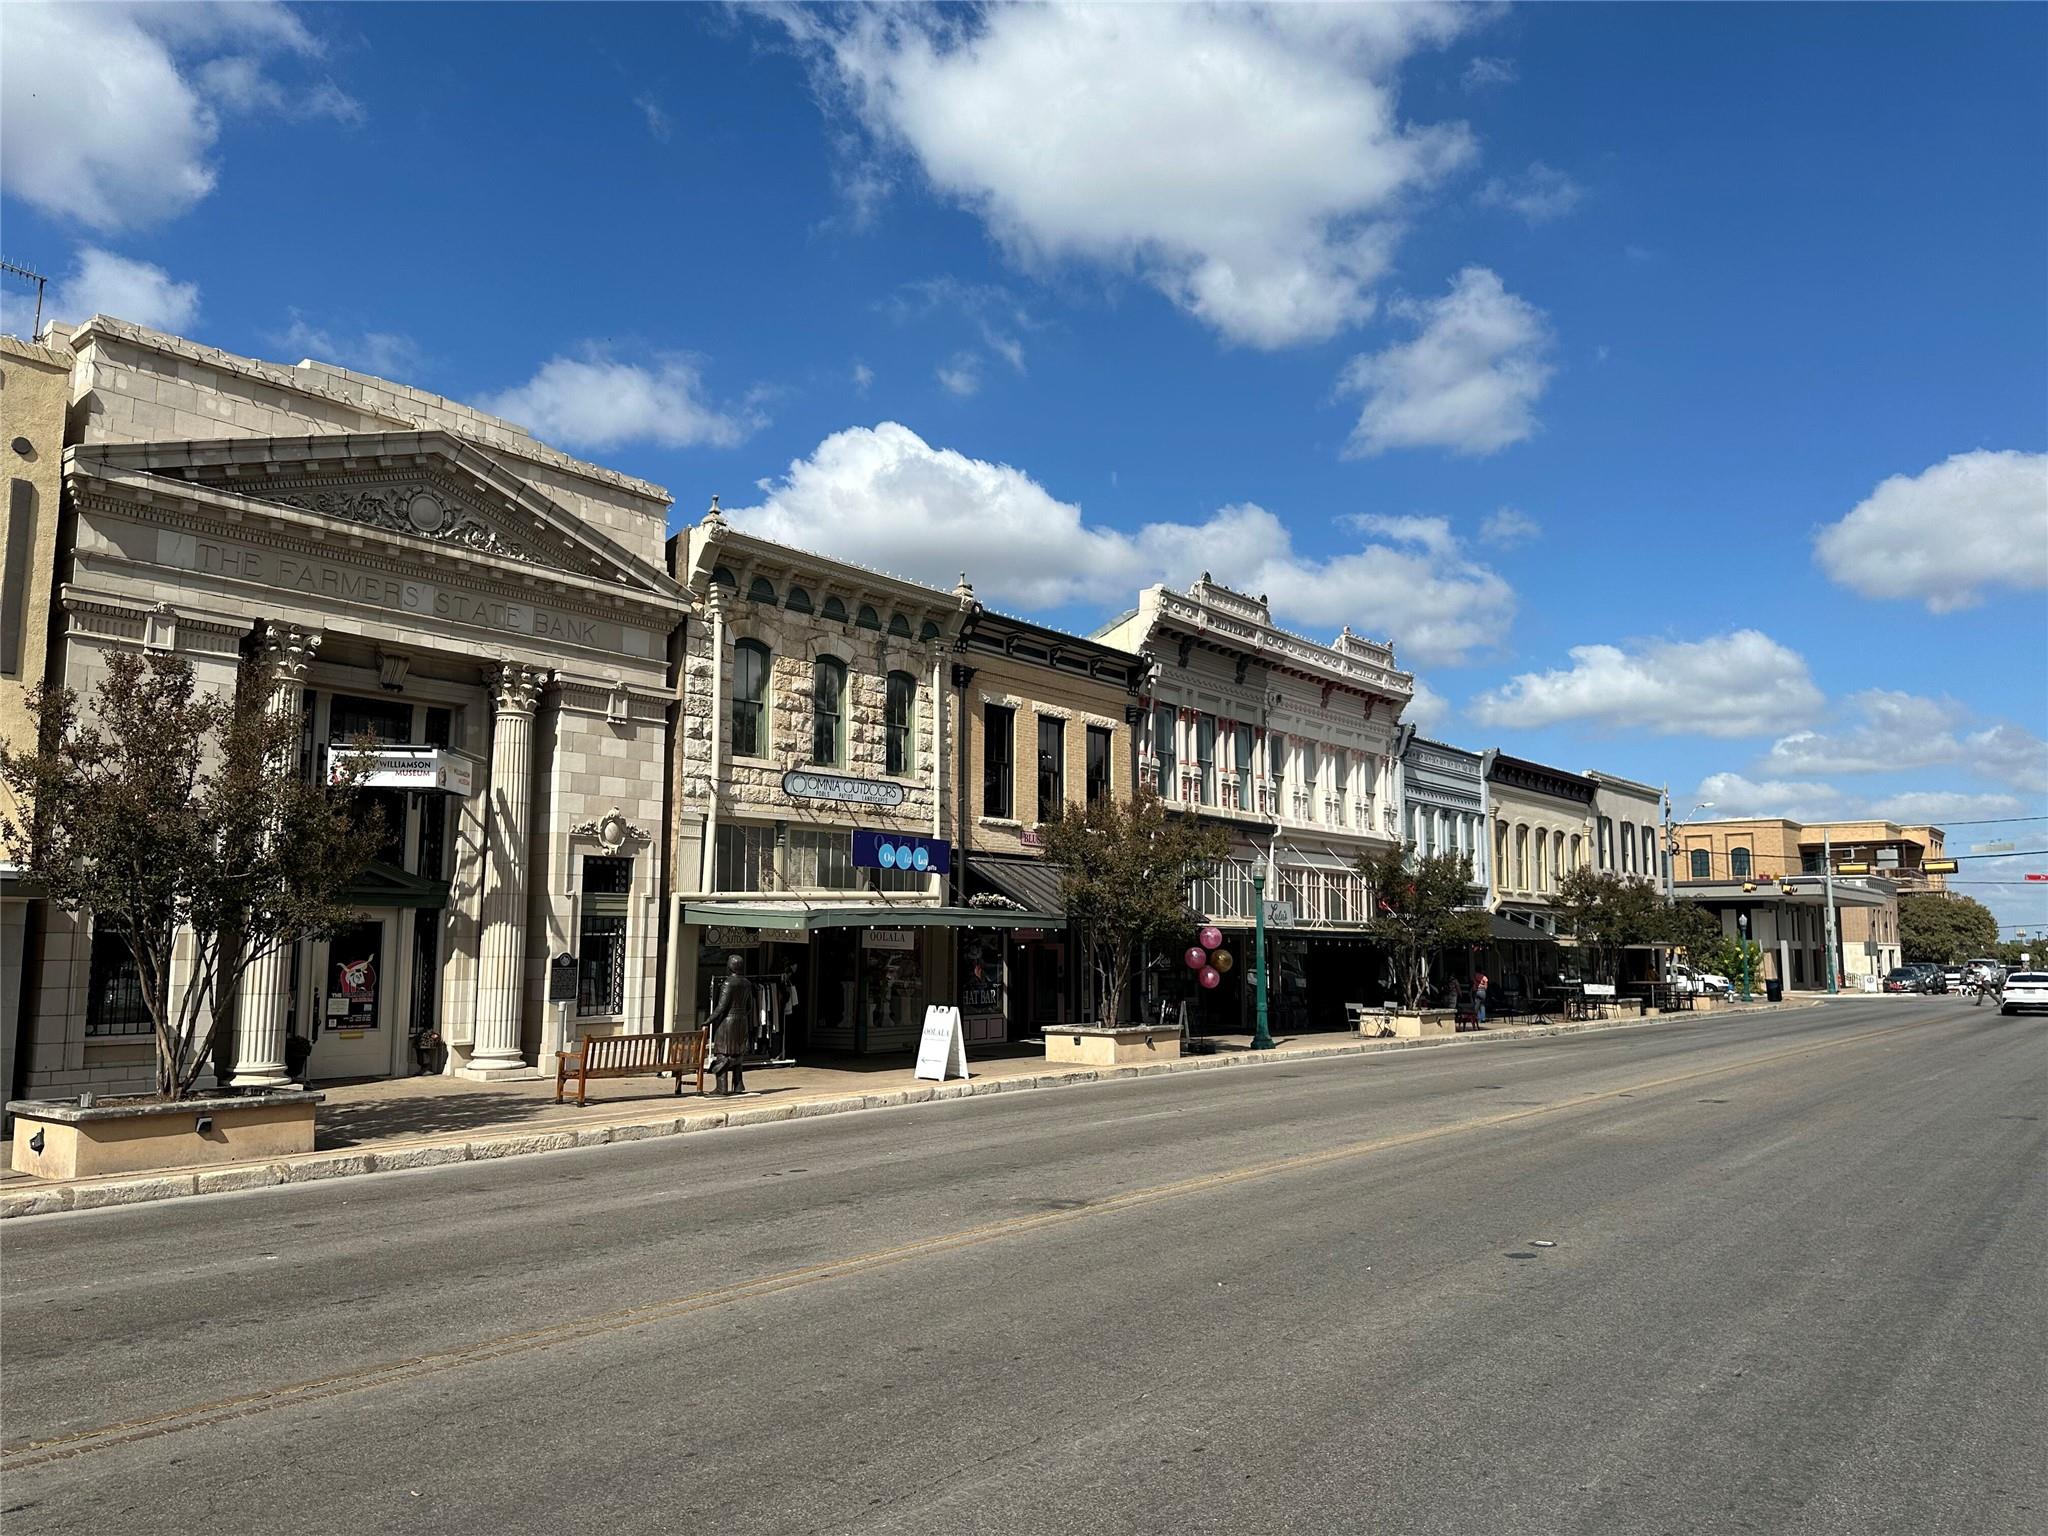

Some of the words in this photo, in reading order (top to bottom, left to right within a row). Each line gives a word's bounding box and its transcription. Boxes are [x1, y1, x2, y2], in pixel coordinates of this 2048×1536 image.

[199, 544, 263, 577] THE
[435, 592, 521, 628] STATE
[535, 613, 597, 643] BANK
[380, 761, 431, 769] WILLIAMSON
[808, 776, 840, 791] OMNIA
[844, 780, 897, 798] OUTDOORS
[869, 931, 905, 943] OOLALA
[981, 989, 996, 1004] BAR
